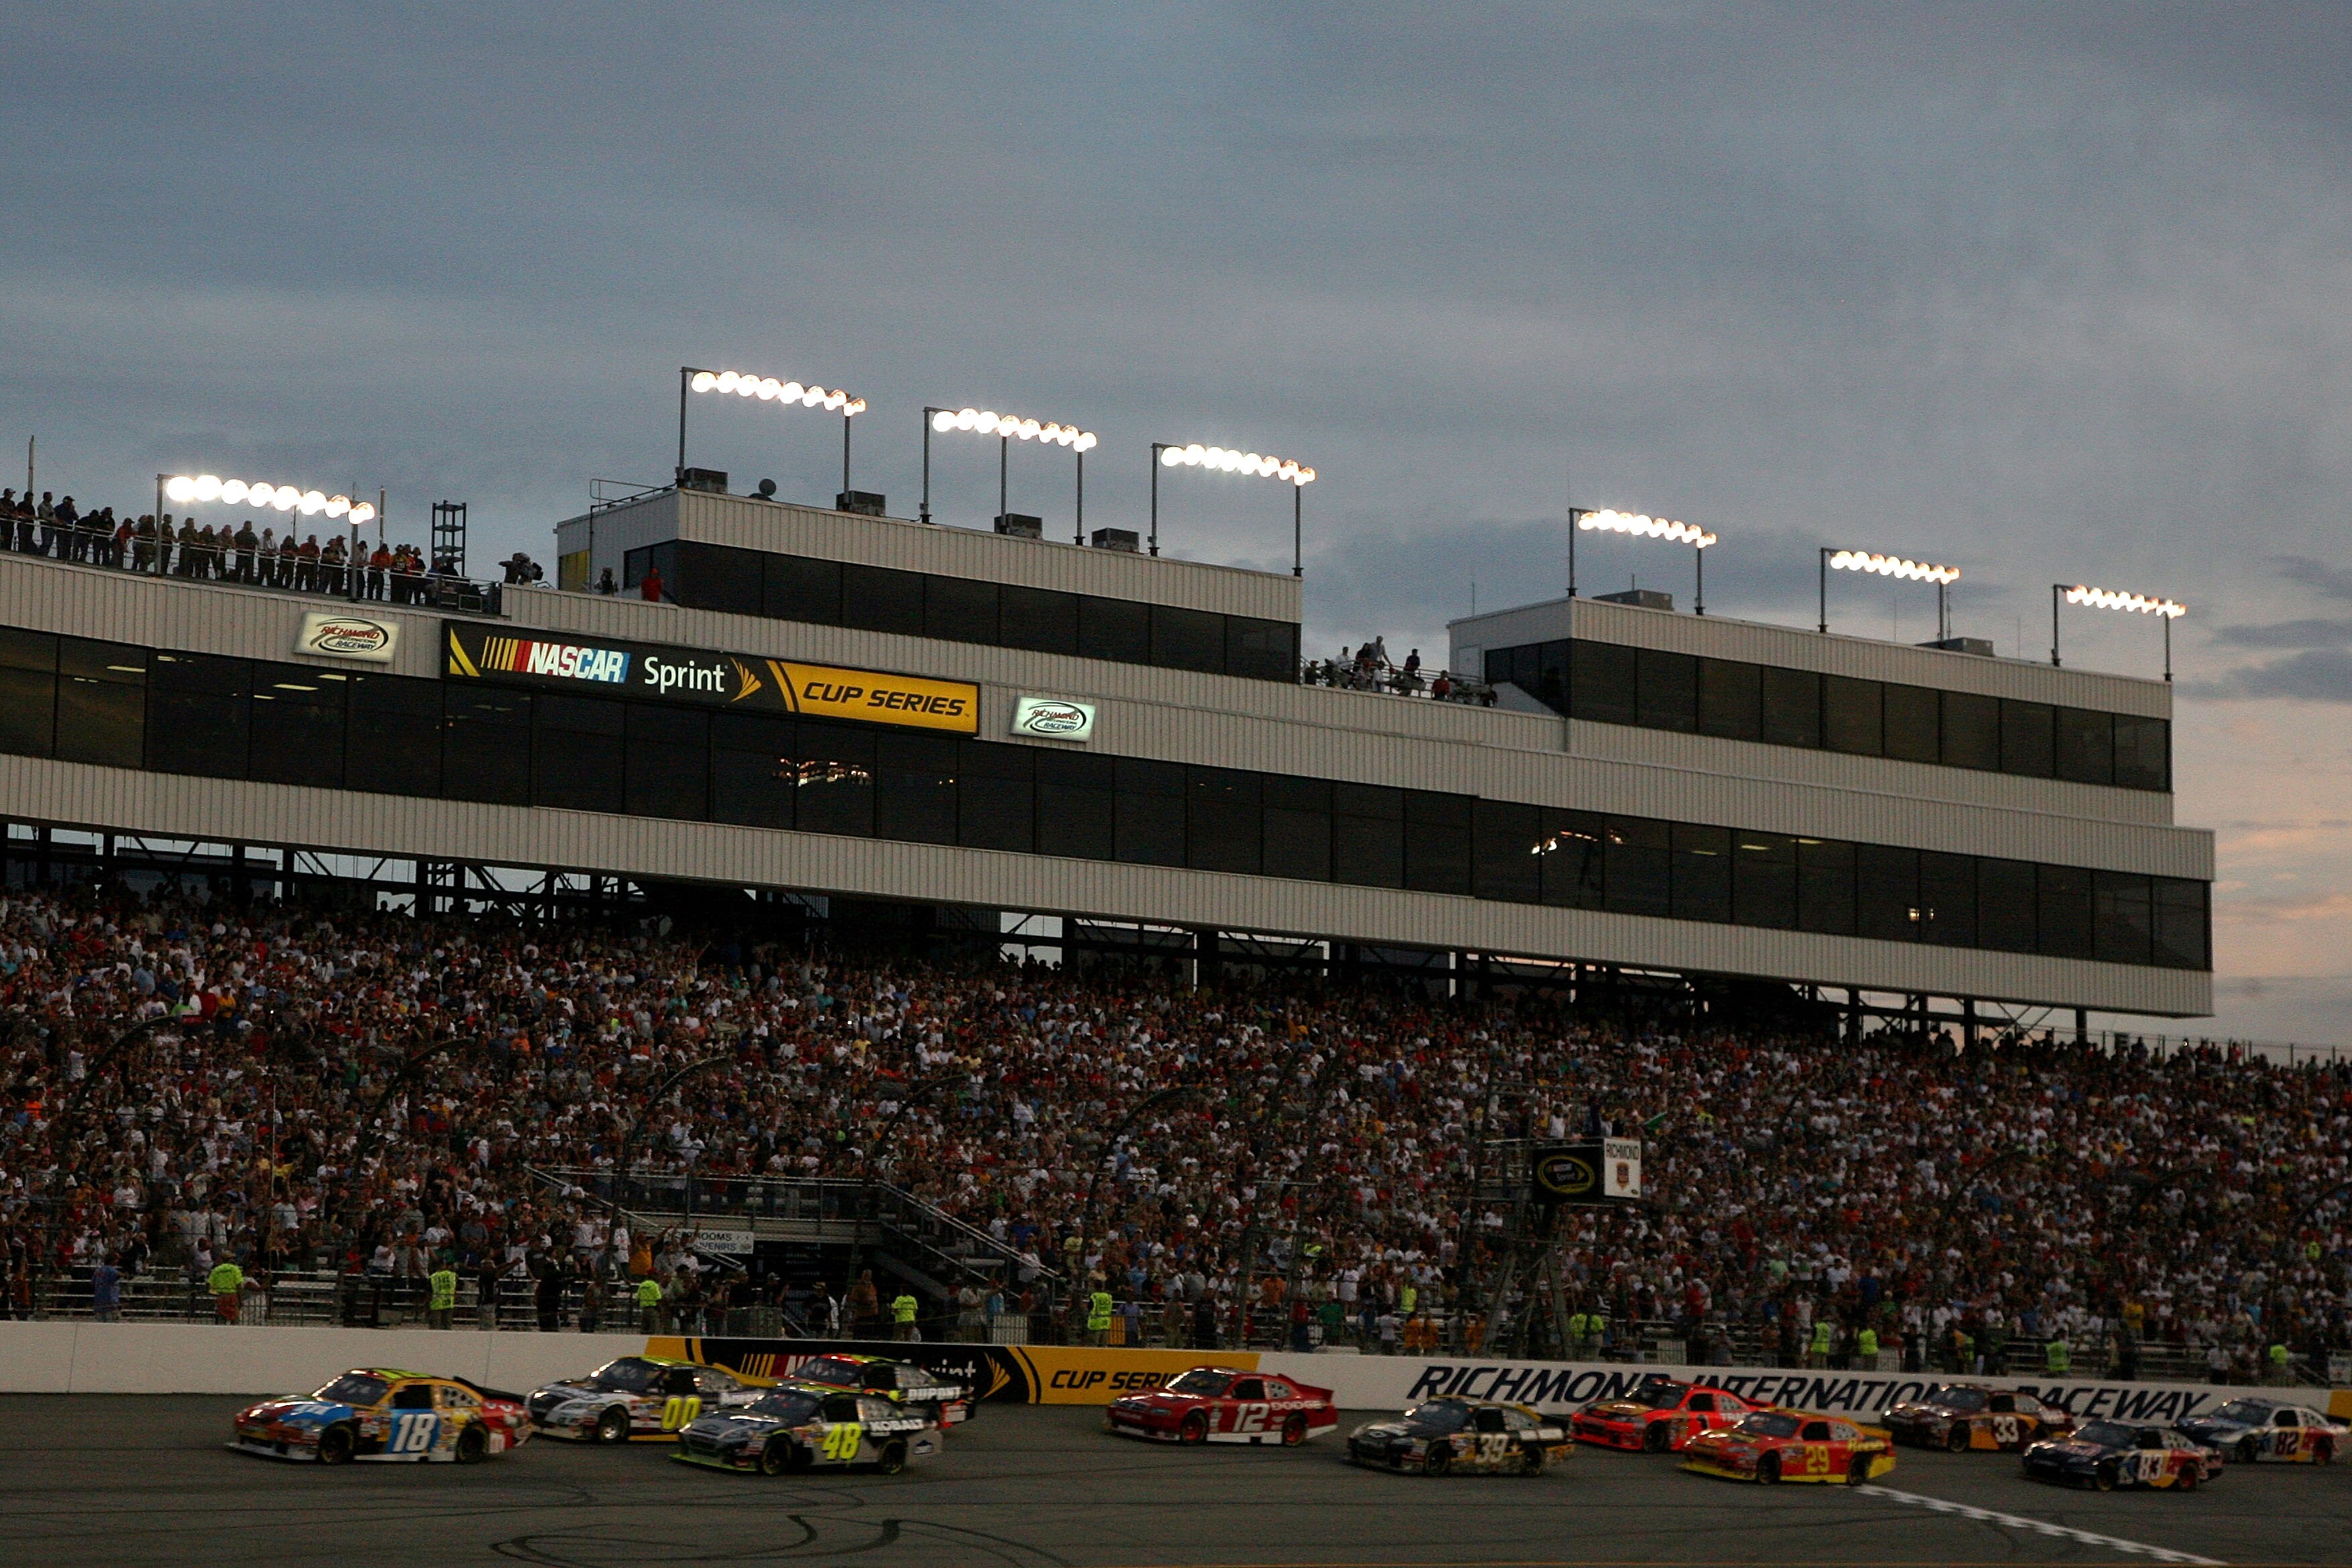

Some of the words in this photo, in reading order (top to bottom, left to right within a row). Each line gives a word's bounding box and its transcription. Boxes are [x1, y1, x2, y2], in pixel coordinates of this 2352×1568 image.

[320, 625, 379, 640] RICHMOND
[336, 641, 376, 650] RACEWAY
[527, 642, 624, 683] NASCAR
[644, 656, 725, 693] Sprint
[803, 682, 863, 704] CUP
[866, 689, 966, 717] SERIES
[1032, 709, 1079, 721] RICHMOND
[1606, 1143, 1639, 1160] RICHMOND
[1051, 1370, 1106, 1388] CUP
[1108, 1372, 1179, 1390] SERI
[660, 1395, 702, 1431] 00
[1232, 1402, 1270, 1433] 12
[393, 1413, 436, 1453] 18
[822, 1423, 863, 1461] 48
[1993, 1415, 2020, 1443] 33
[2274, 1431, 2299, 1455] 82
[1476, 1433, 1509, 1463] 39
[1806, 1445, 1830, 1473] 29
[2137, 1453, 2164, 1481] 83
